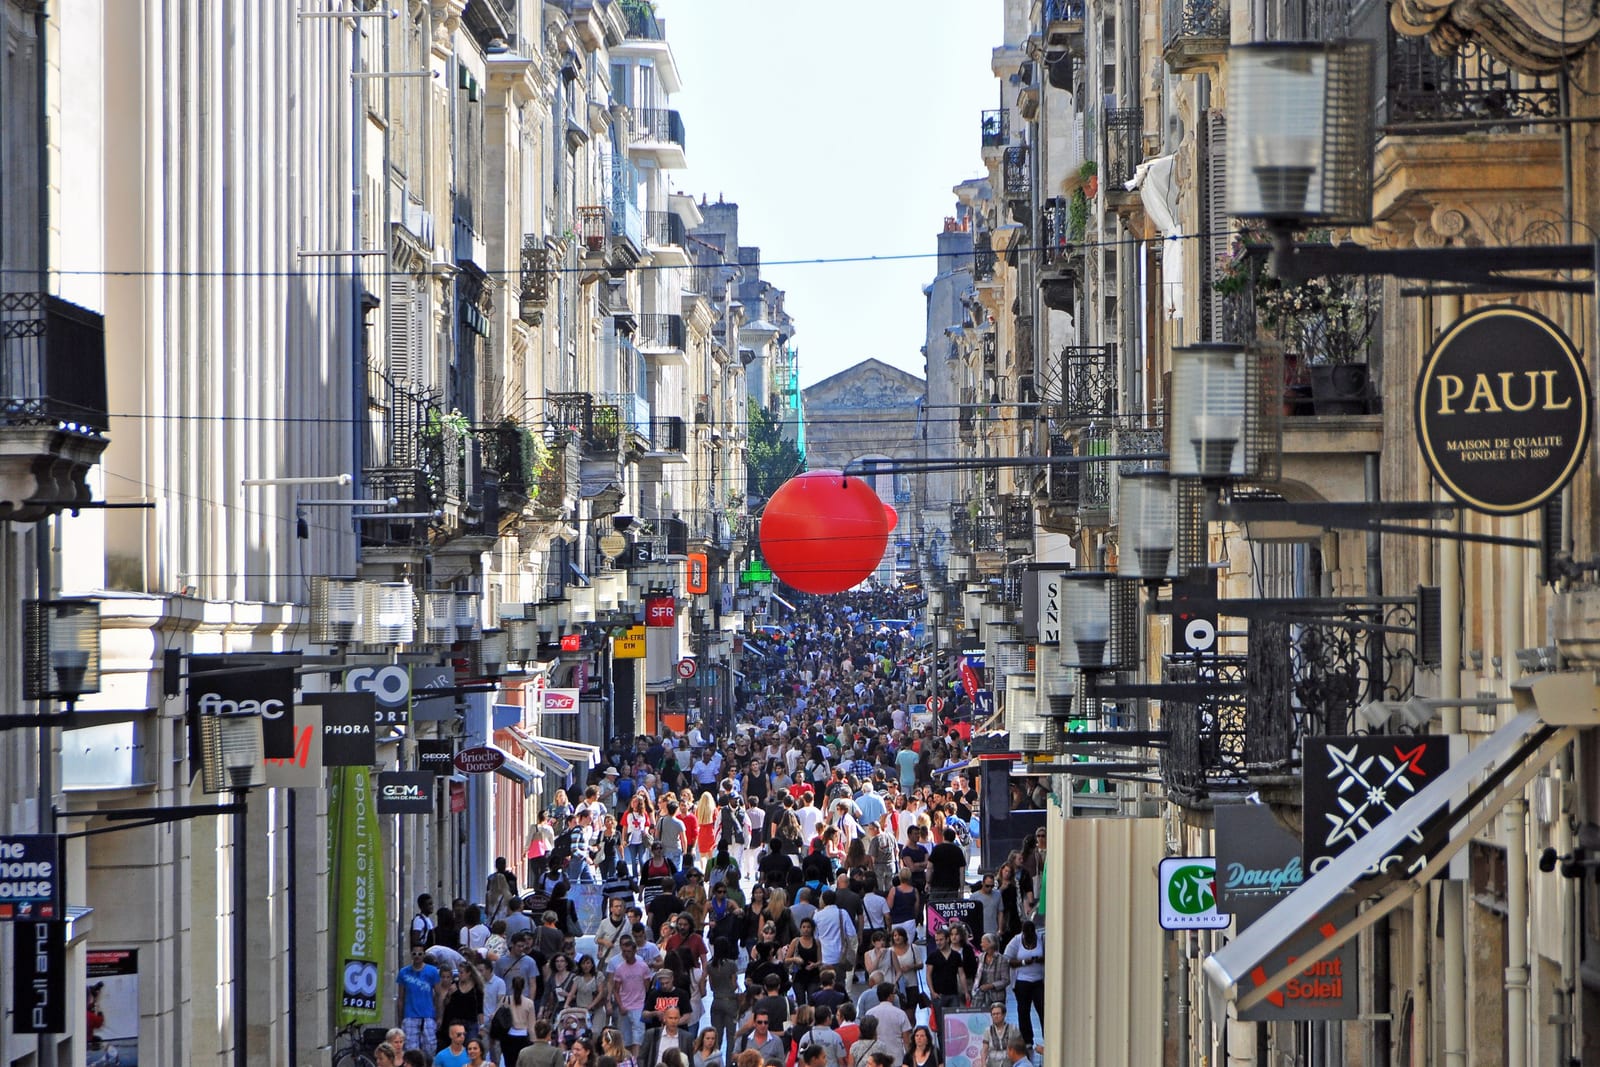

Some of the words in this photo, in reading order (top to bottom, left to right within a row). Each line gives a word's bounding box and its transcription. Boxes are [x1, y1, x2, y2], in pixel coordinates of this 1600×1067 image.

[1436, 371, 1572, 414] PAUL
[1447, 439, 1490, 451] MAISON
[1495, 438, 1510, 449] DE
[1514, 436, 1562, 449] QUALITE
[1461, 450, 1507, 462] FONDEE
[1511, 448, 1526, 460] EN
[1530, 448, 1549, 458] 1889
[652, 607, 674, 617] SFR
[1046, 583, 1059, 624] SAN
[346, 666, 409, 703] GO
[198, 693, 285, 719] fnac
[546, 698, 574, 709] SNCF
[325, 725, 370, 734] PHORA
[460, 750, 500, 763] Brioche
[353, 773, 366, 837] mode
[354, 844, 366, 871] en
[352, 877, 366, 957] Rentrez
[935, 902, 956, 911] TENUE
[35, 923, 48, 972] and
[345, 962, 377, 996] GO
[1286, 978, 1343, 999] Soleil
[32, 979, 48, 1028] Pull
[343, 997, 376, 1009] SPORT
